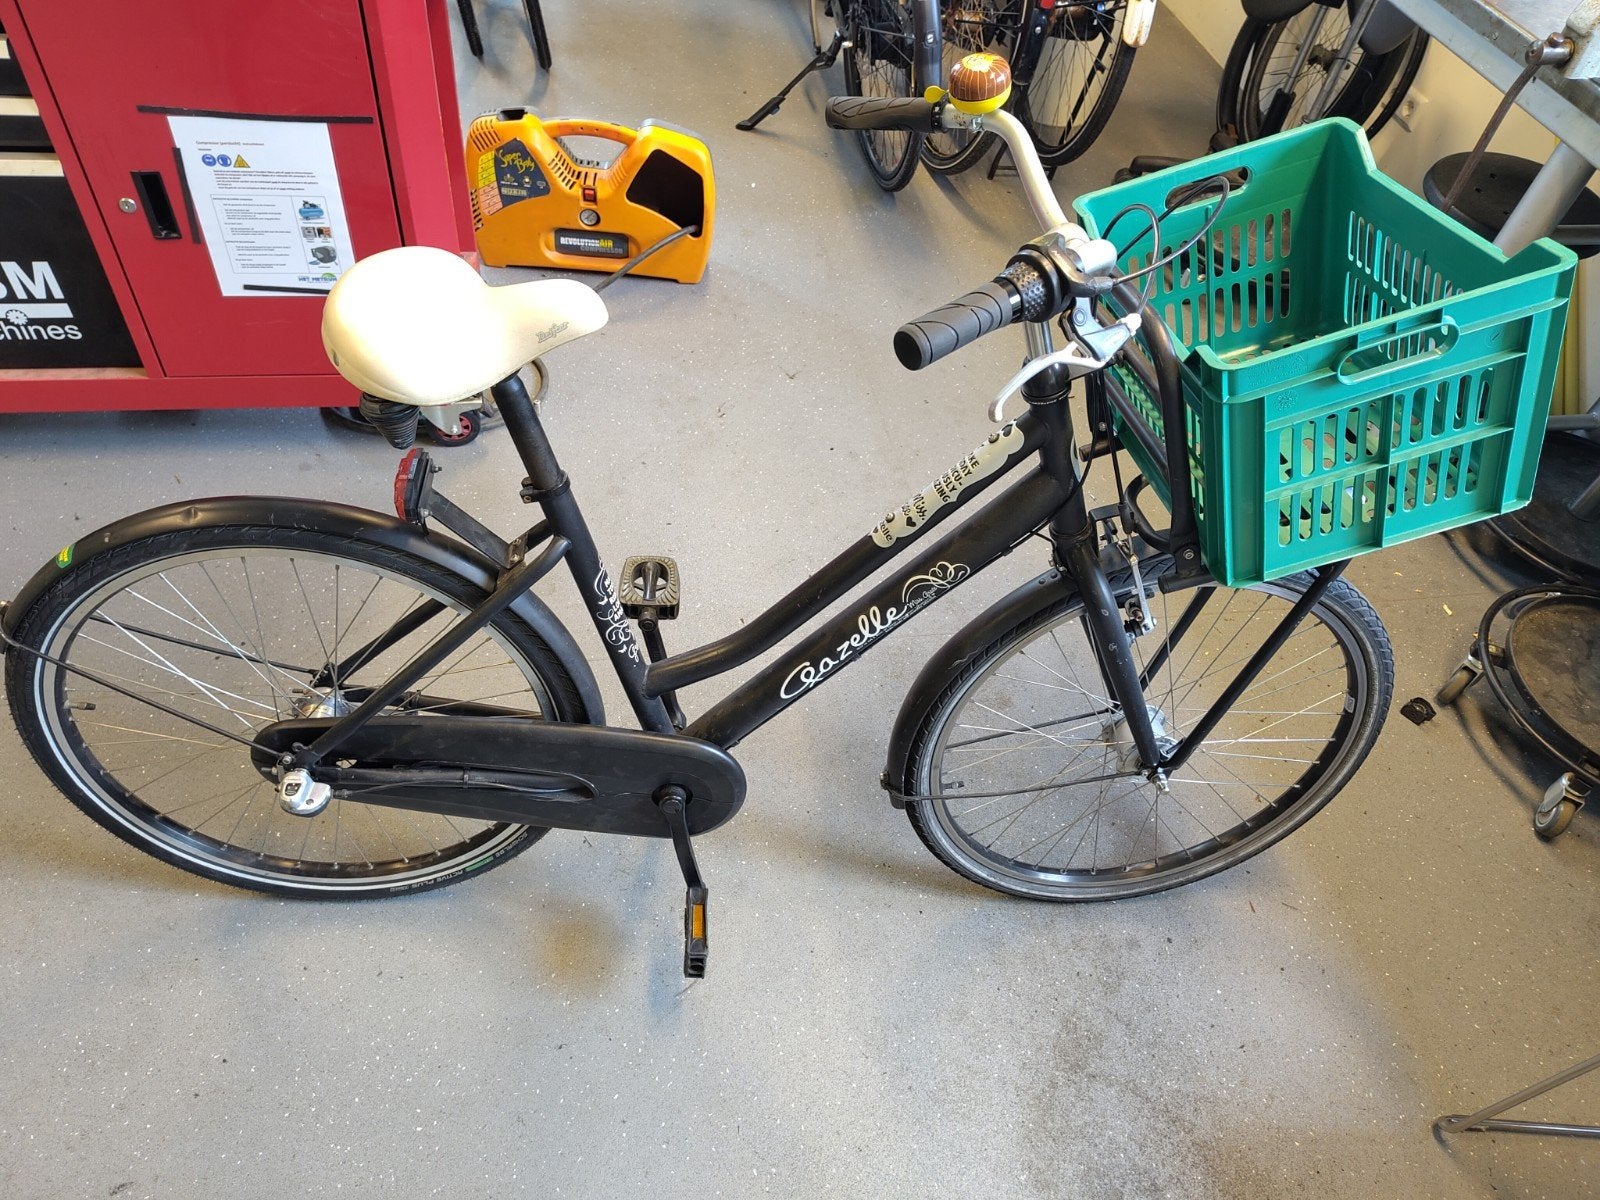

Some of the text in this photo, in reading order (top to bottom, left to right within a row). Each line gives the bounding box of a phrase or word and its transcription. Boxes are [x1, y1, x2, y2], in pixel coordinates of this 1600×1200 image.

[0, 261, 65, 299] M
[780, 605, 908, 700] Gazelle
[411, 879, 435, 890] PLUS
[436, 869, 464, 883] ACTIVE
